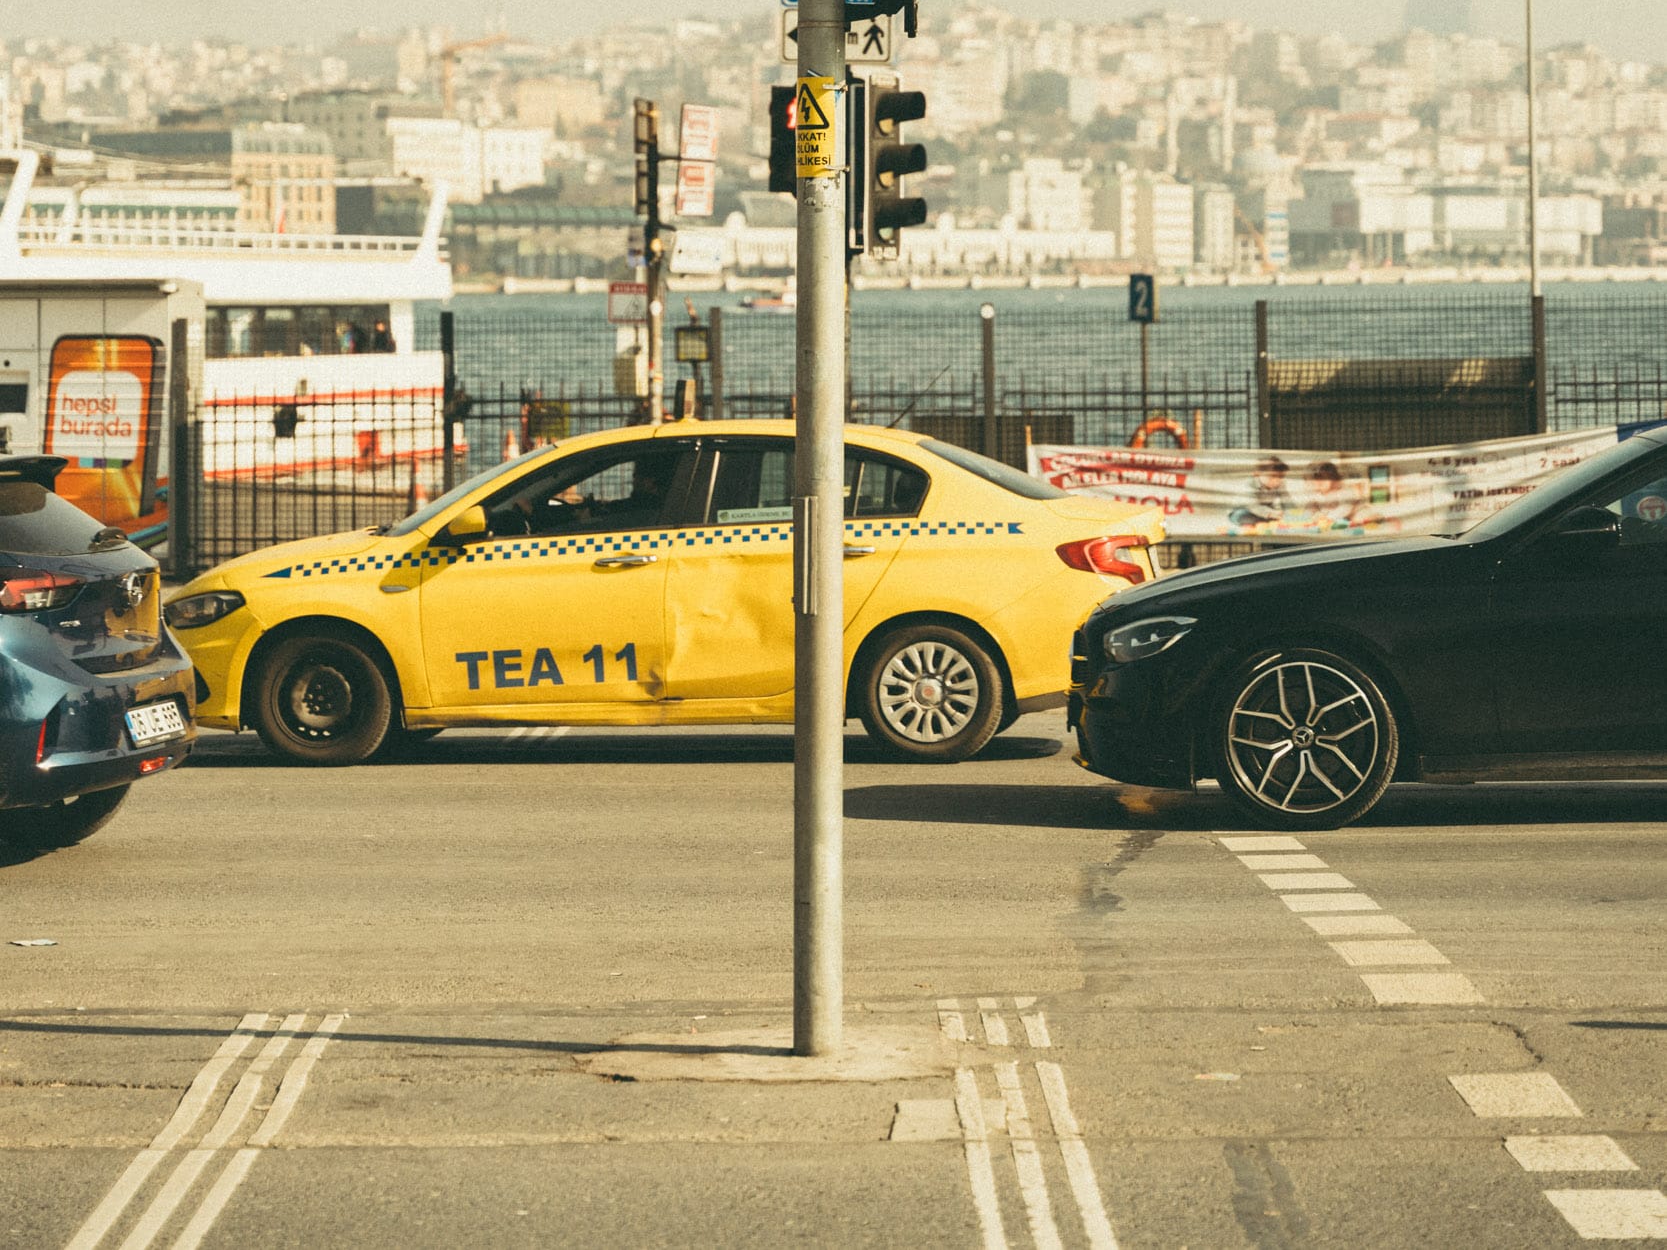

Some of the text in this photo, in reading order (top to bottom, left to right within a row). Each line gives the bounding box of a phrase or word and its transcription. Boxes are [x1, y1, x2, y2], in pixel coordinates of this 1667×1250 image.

[1135, 281, 1148, 317] 2
[62, 392, 117, 417] hepsi
[60, 415, 132, 437] burada
[455, 642, 638, 690] TEA 11
